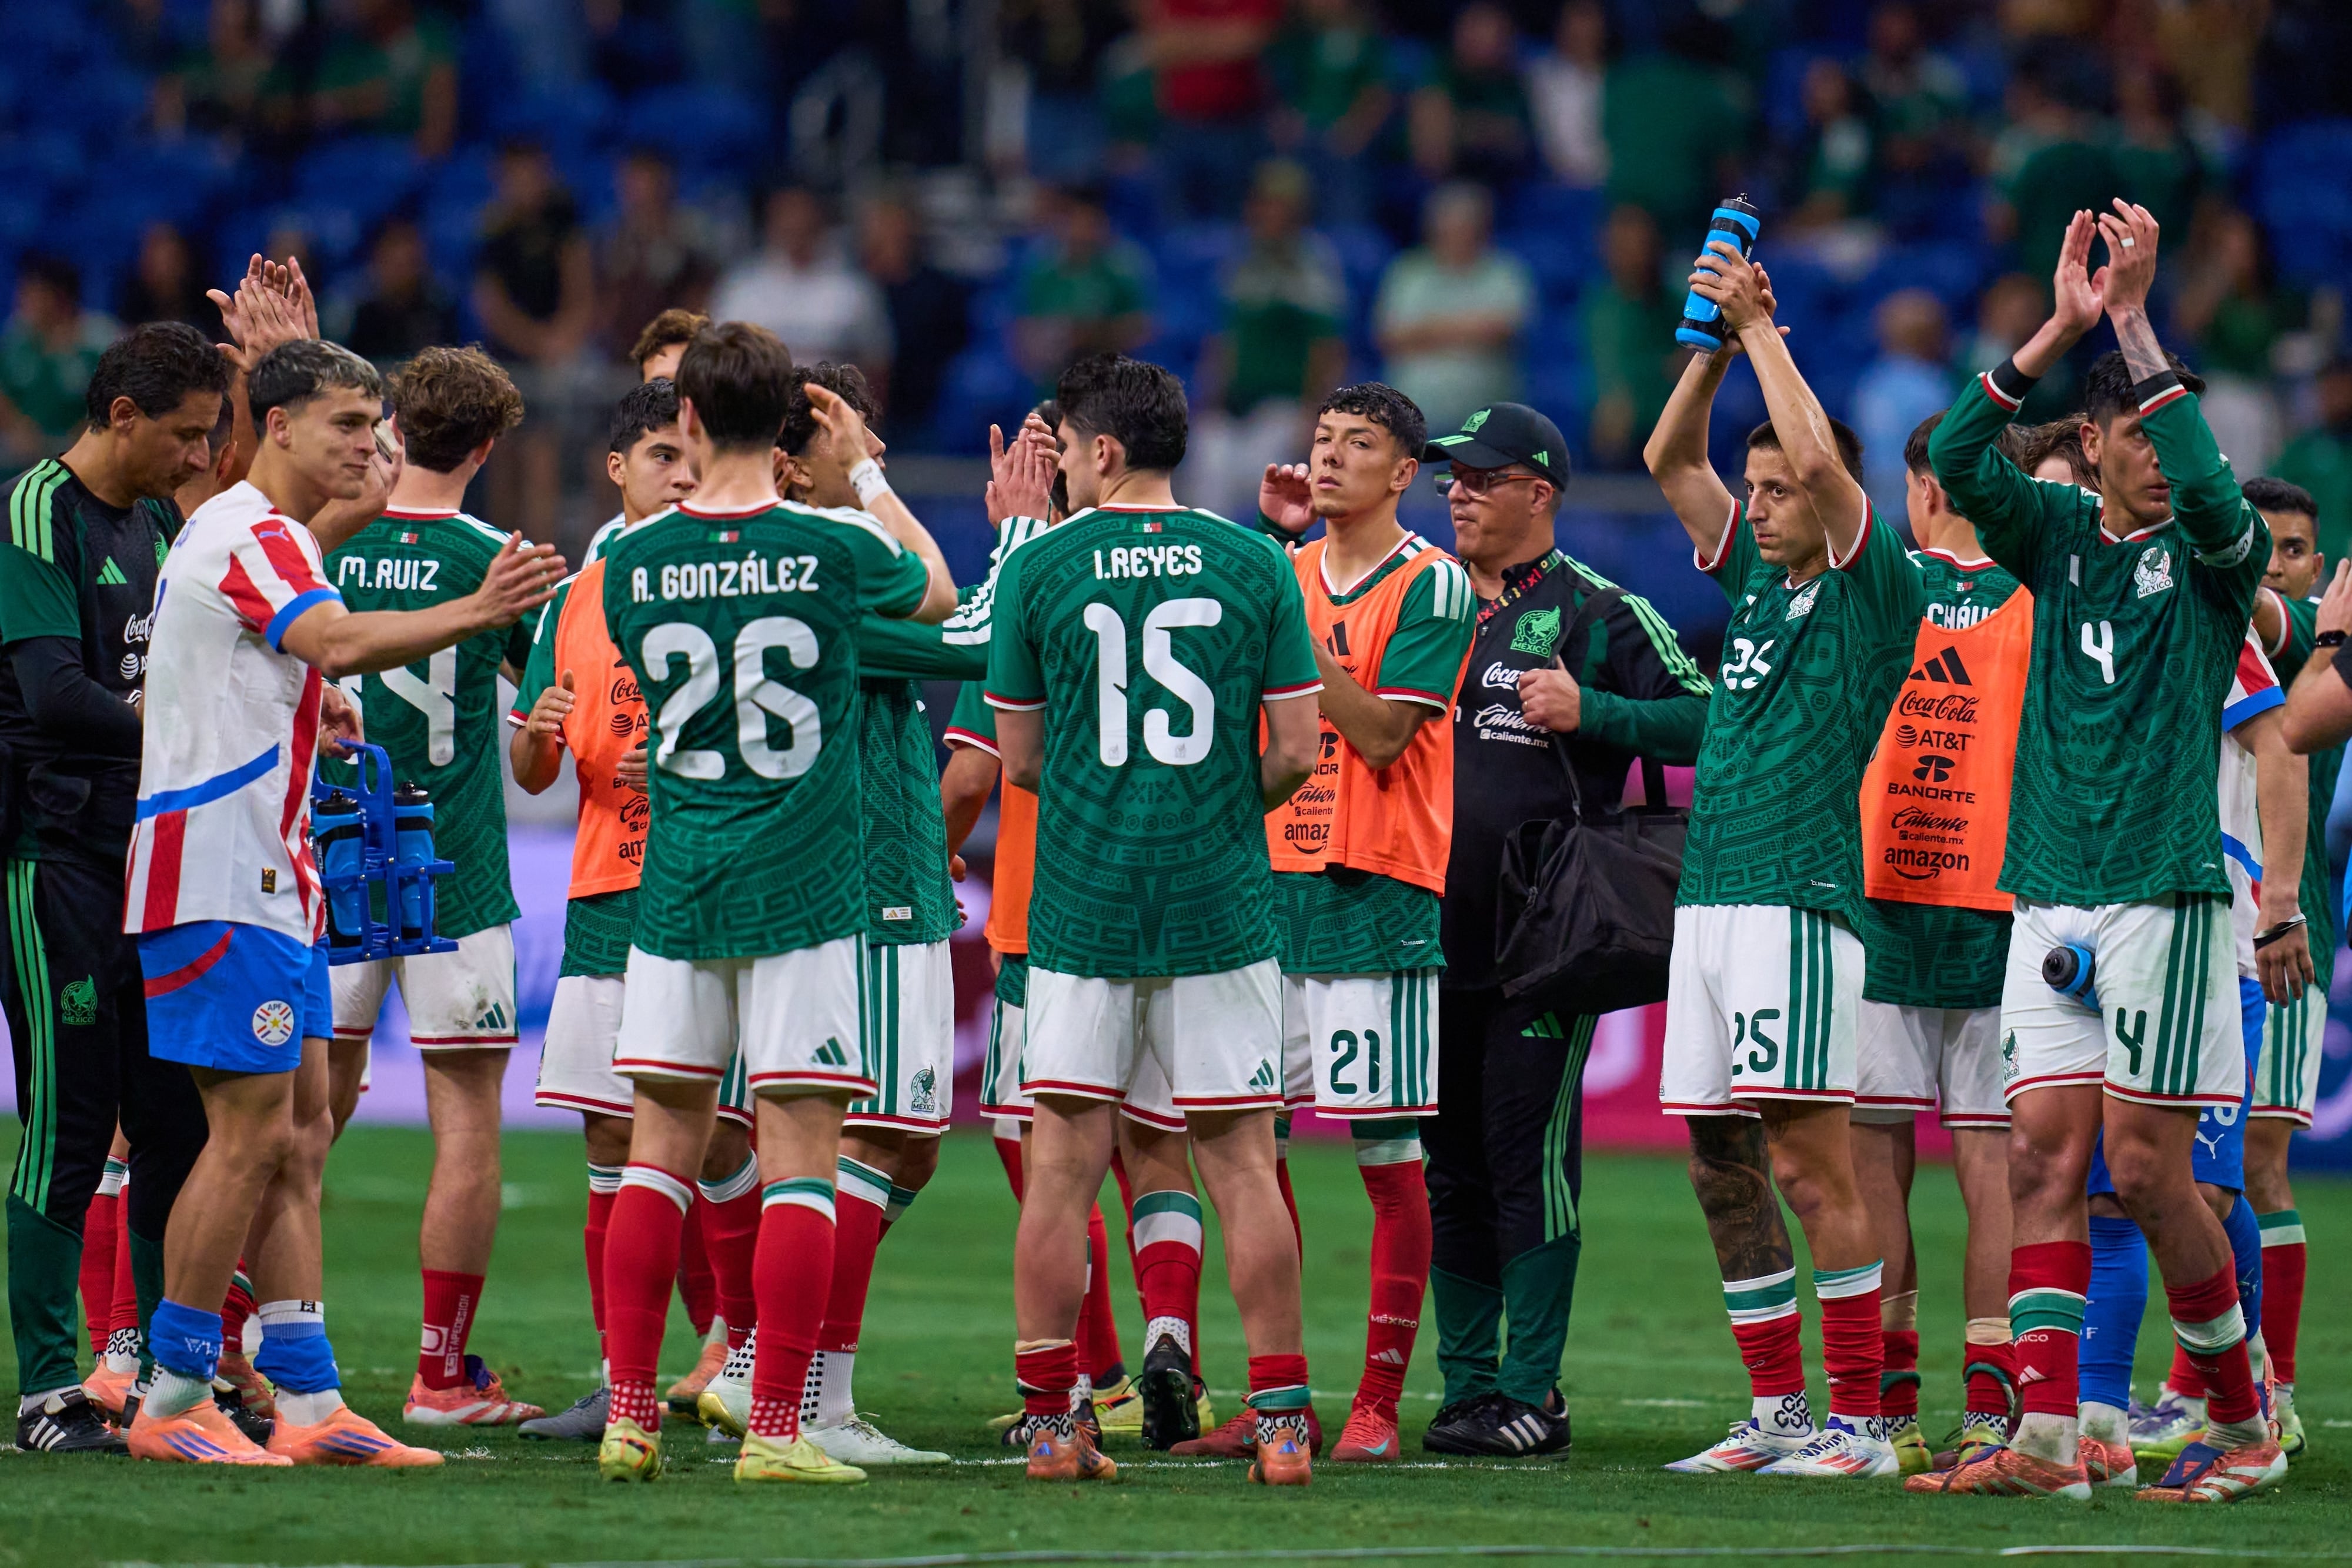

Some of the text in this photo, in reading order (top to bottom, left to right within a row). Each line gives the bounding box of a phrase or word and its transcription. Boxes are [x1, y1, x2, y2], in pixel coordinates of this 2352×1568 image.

[338, 556, 440, 591] M.RUIZ
[632, 550, 819, 603] A. GONZÁLEZ
[1094, 545, 1202, 580] I.REYES
[1513, 641, 1549, 656] MÉXICO
[2082, 620, 2115, 684] 4
[642, 616, 823, 780] 26
[1083, 598, 1222, 767] 15
[1899, 690, 1980, 723] Coca-Cola
[1491, 730, 1549, 748] caliente.mx
[1919, 730, 1972, 751] AT&T
[1887, 783, 1976, 804] BANORTE
[1891, 805, 1969, 832] Caliente
[1909, 832, 1964, 845] caliente.mx
[1884, 847, 1969, 871] amazon
[1732, 1008, 1780, 1073] 25
[2116, 1007, 2146, 1075] 4
[1331, 1029, 1380, 1094] 21
[1371, 1314, 1417, 1328] MÉXICO
